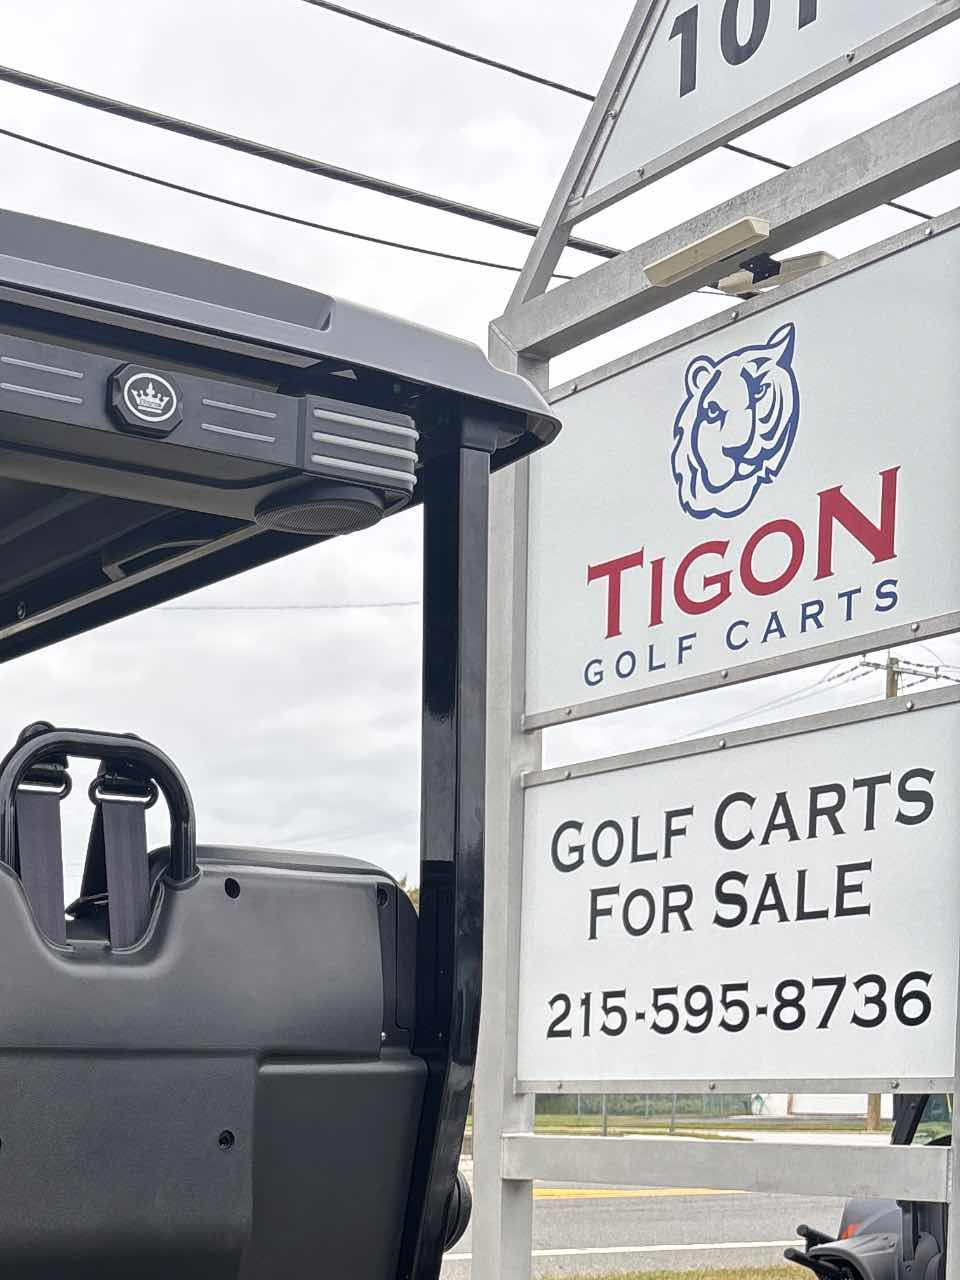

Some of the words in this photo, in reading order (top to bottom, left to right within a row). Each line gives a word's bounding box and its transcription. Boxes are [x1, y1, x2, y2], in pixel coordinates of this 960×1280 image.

[587, 465, 901, 639] TIGON
[583, 632, 698, 687] GOLF
[725, 578, 900, 651] CARTS
[551, 805, 694, 873] GOLF
[713, 768, 936, 851] CARTS
[588, 883, 694, 940] FOR
[712, 858, 873, 929] SALE
[546, 971, 934, 1039] 215-595-8736
